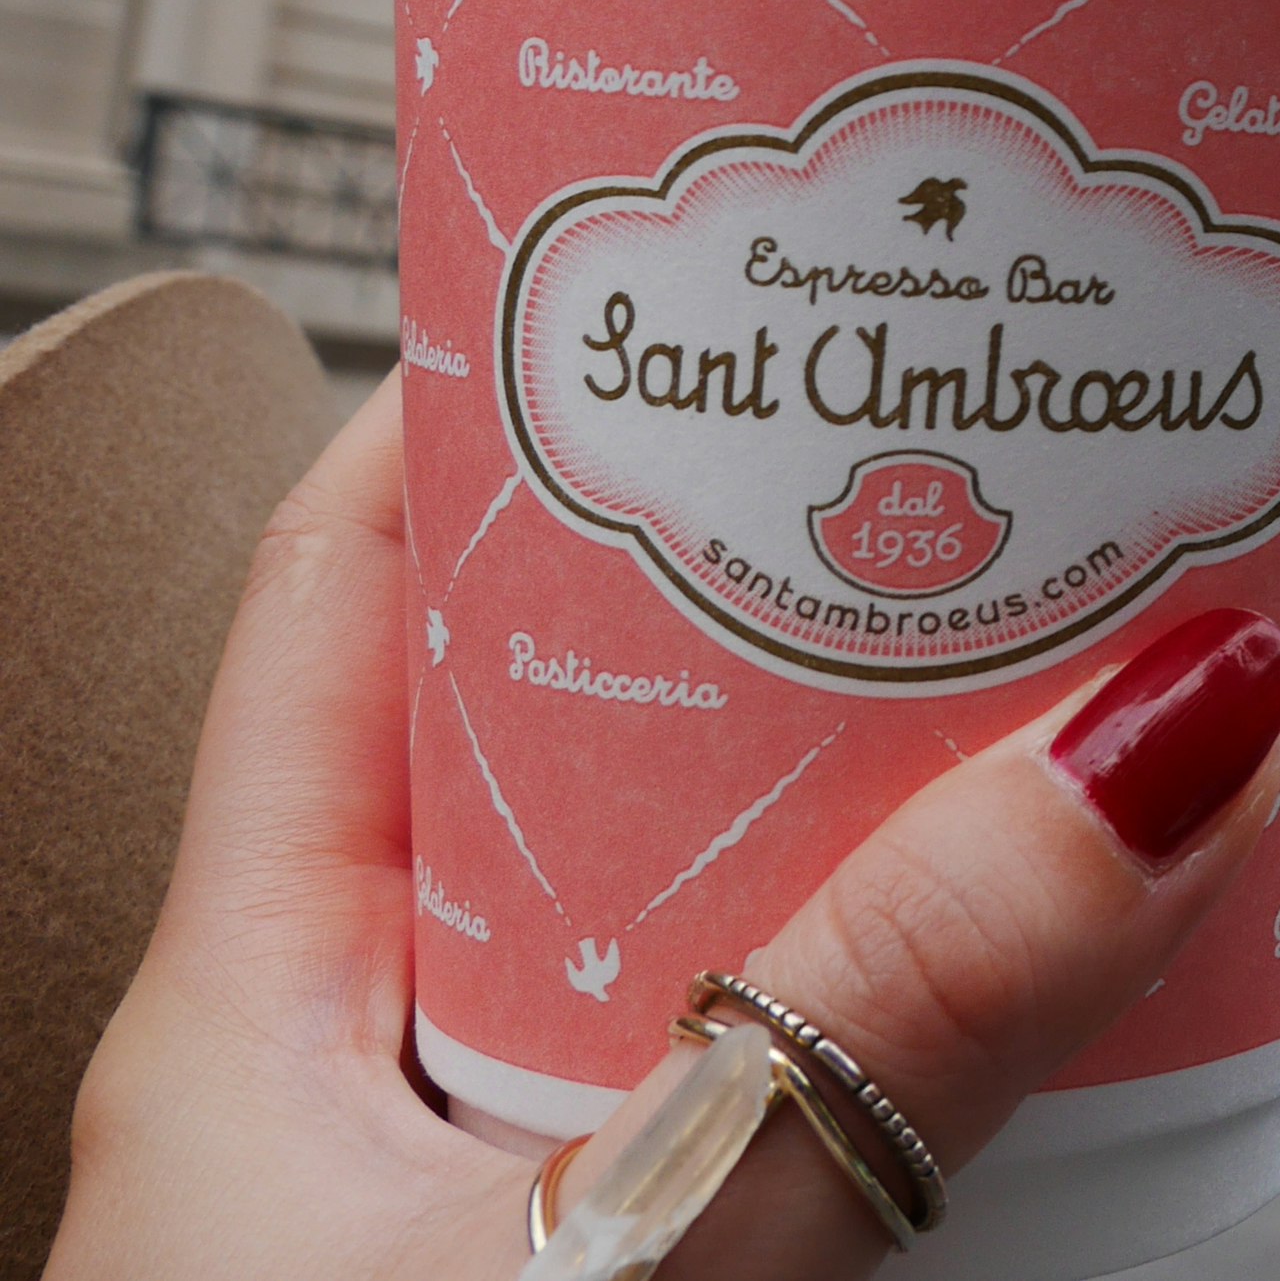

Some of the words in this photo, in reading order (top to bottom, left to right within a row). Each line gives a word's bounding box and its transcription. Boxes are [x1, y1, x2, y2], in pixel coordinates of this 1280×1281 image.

[518, 36, 740, 101] Ristorante
[745, 236, 990, 306] Espresso
[1006, 254, 1117, 306] Bar
[582, 291, 780, 420] Sant
[876, 480, 946, 518] dal
[851, 521, 963, 569] 1936
[701, 538, 1125, 637] santambroeus.com
[508, 631, 729, 710] Pasticceria
